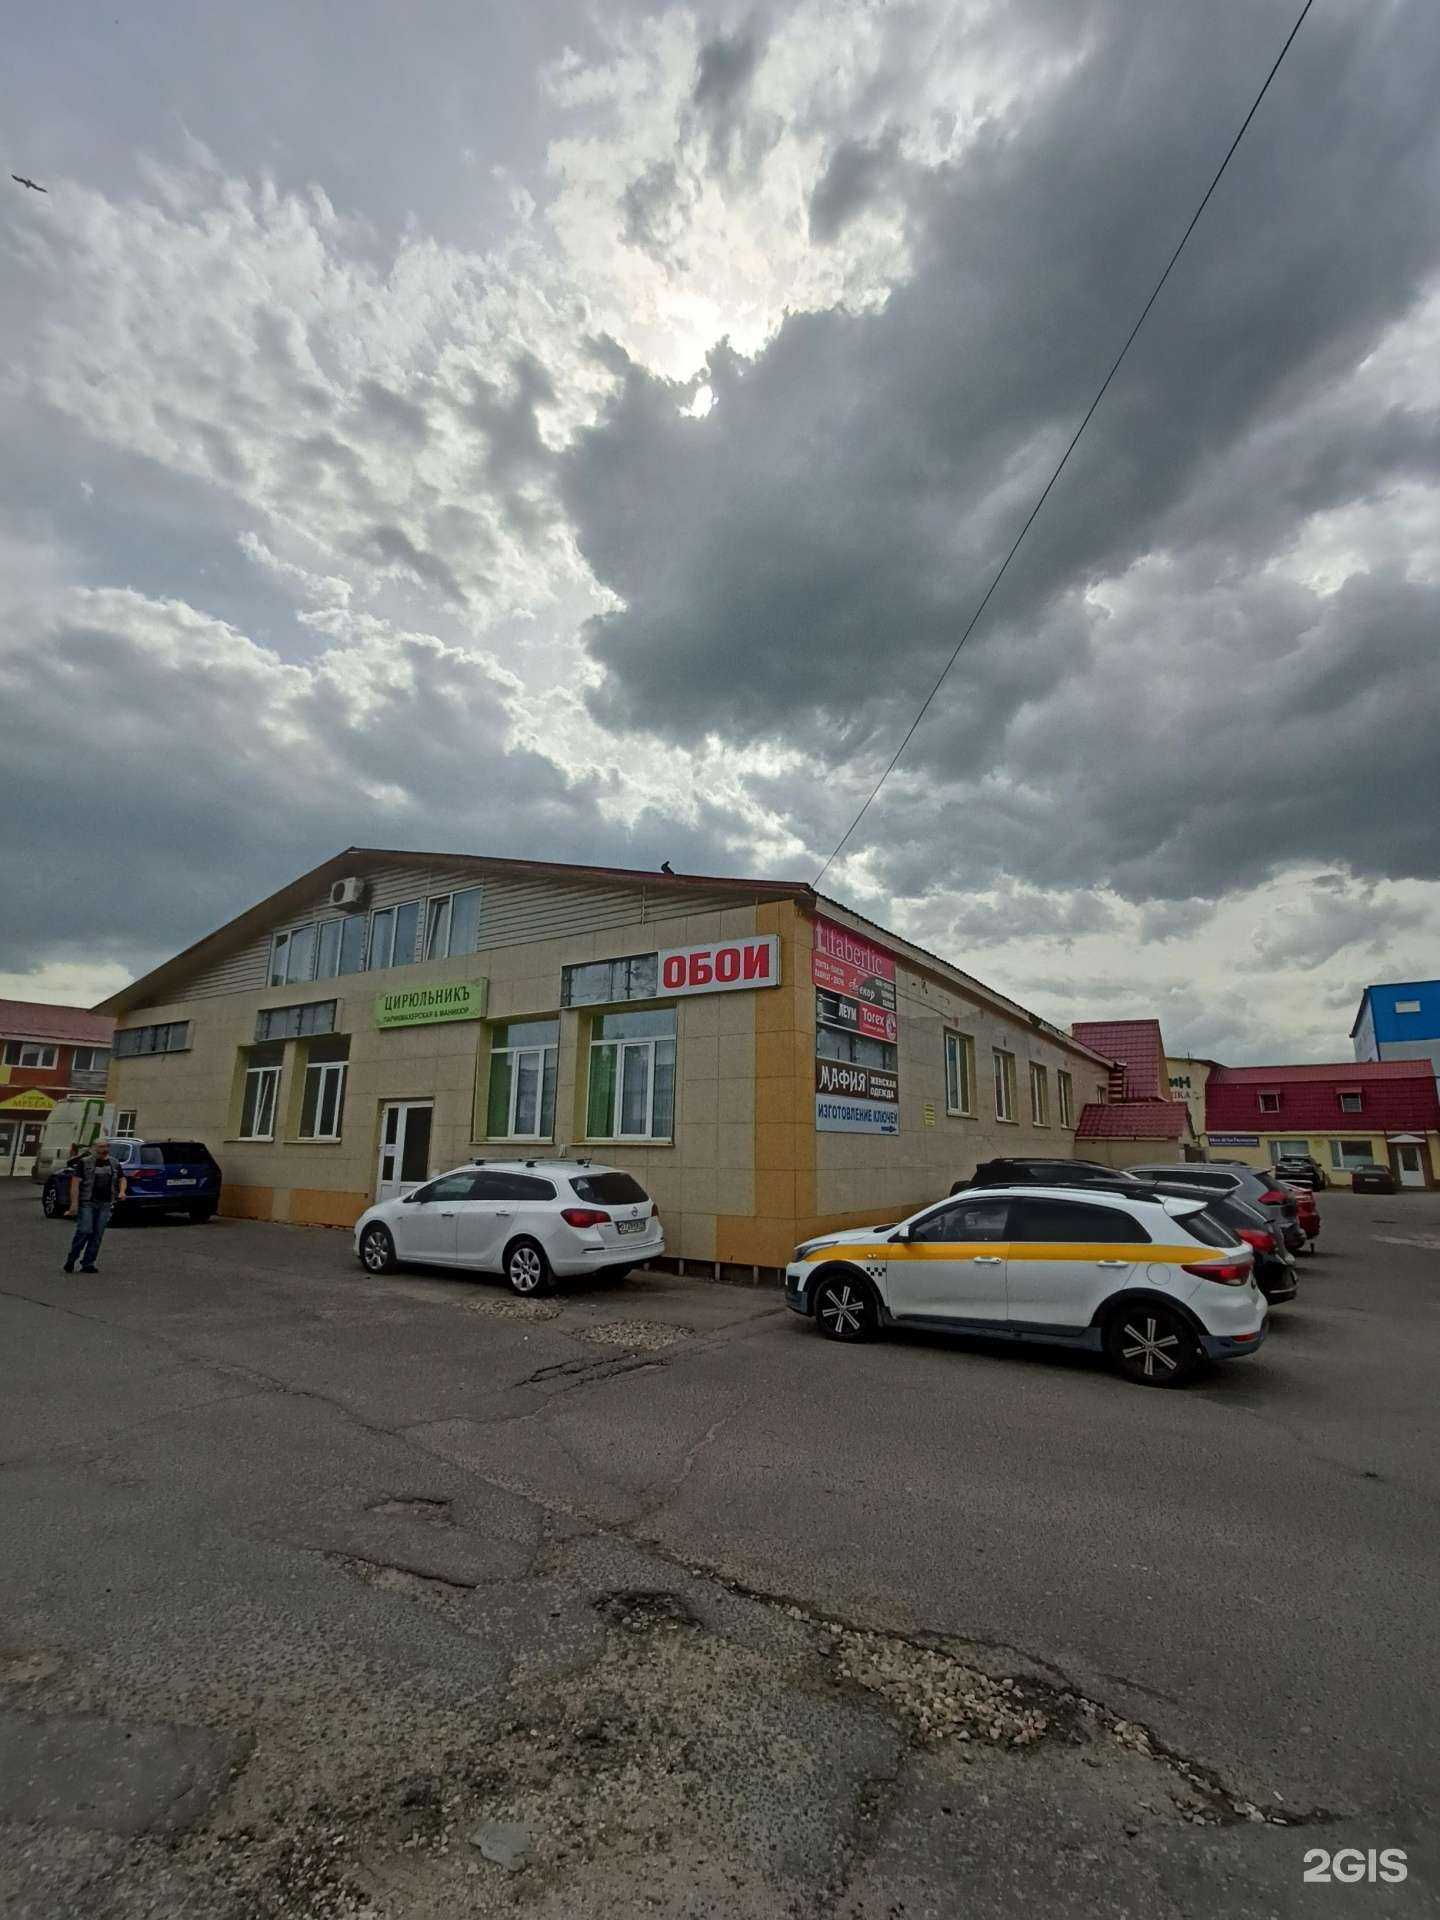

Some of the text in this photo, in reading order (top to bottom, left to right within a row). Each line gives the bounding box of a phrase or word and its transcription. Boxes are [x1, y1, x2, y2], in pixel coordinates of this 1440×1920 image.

[829, 928, 882, 974] faberlic
[663, 944, 770, 989] ОБОИ
[385, 986, 470, 1011] ЦИРЮЛЬНИКЪ
[862, 1007, 885, 1027] Torex
[819, 1065, 867, 1092] МАФИЯ
[870, 1077, 896, 1089] ЖЕНСКАЯ
[870, 1087, 894, 1099] ОДЕЖДА
[818, 1103, 872, 1122] ИЗГОТОВЛЕНИЕ
